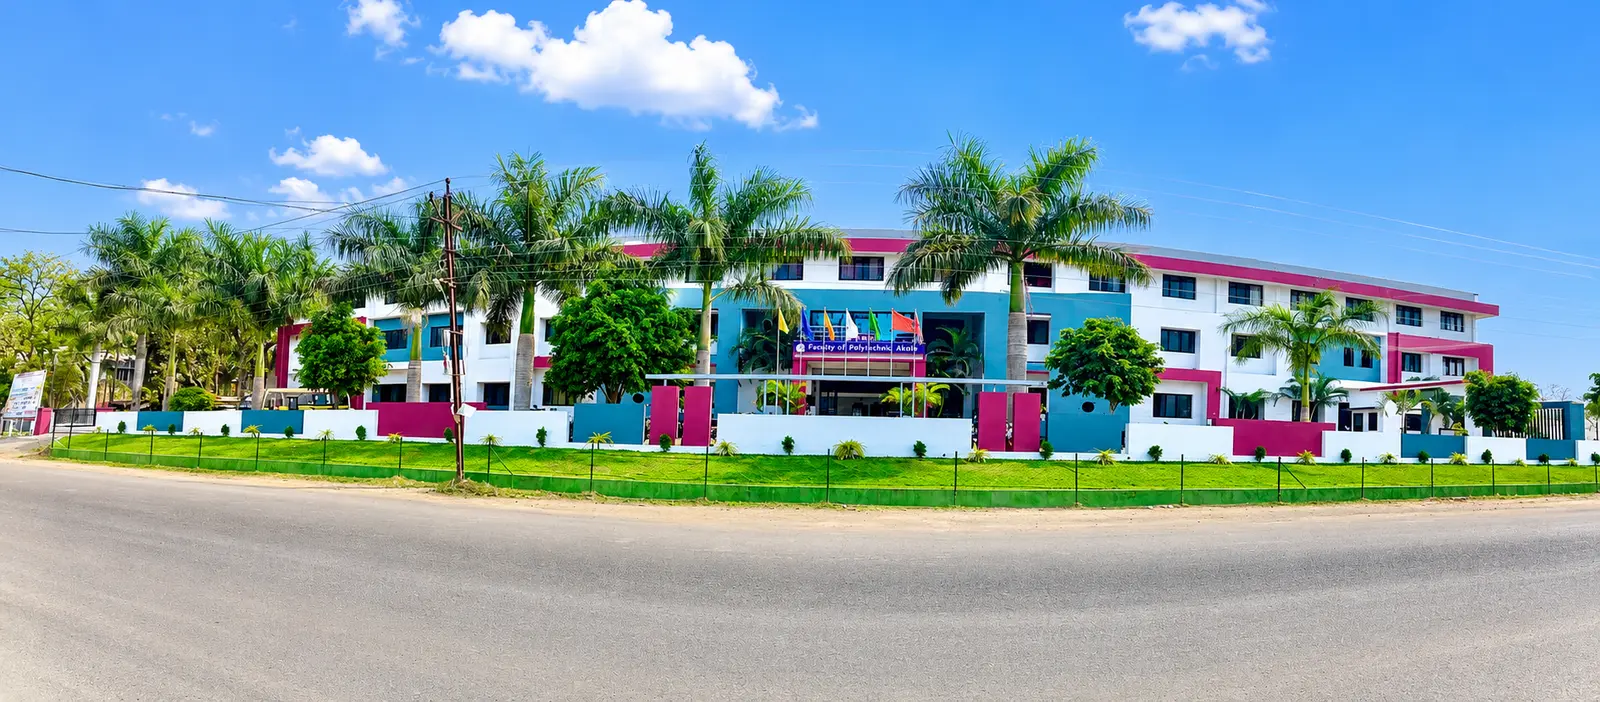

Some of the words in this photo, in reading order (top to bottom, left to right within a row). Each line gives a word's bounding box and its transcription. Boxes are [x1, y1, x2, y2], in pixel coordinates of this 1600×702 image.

[808, 343, 836, 352] Faculty
[837, 343, 846, 351] of
[848, 344, 892, 352] Polytechnic
